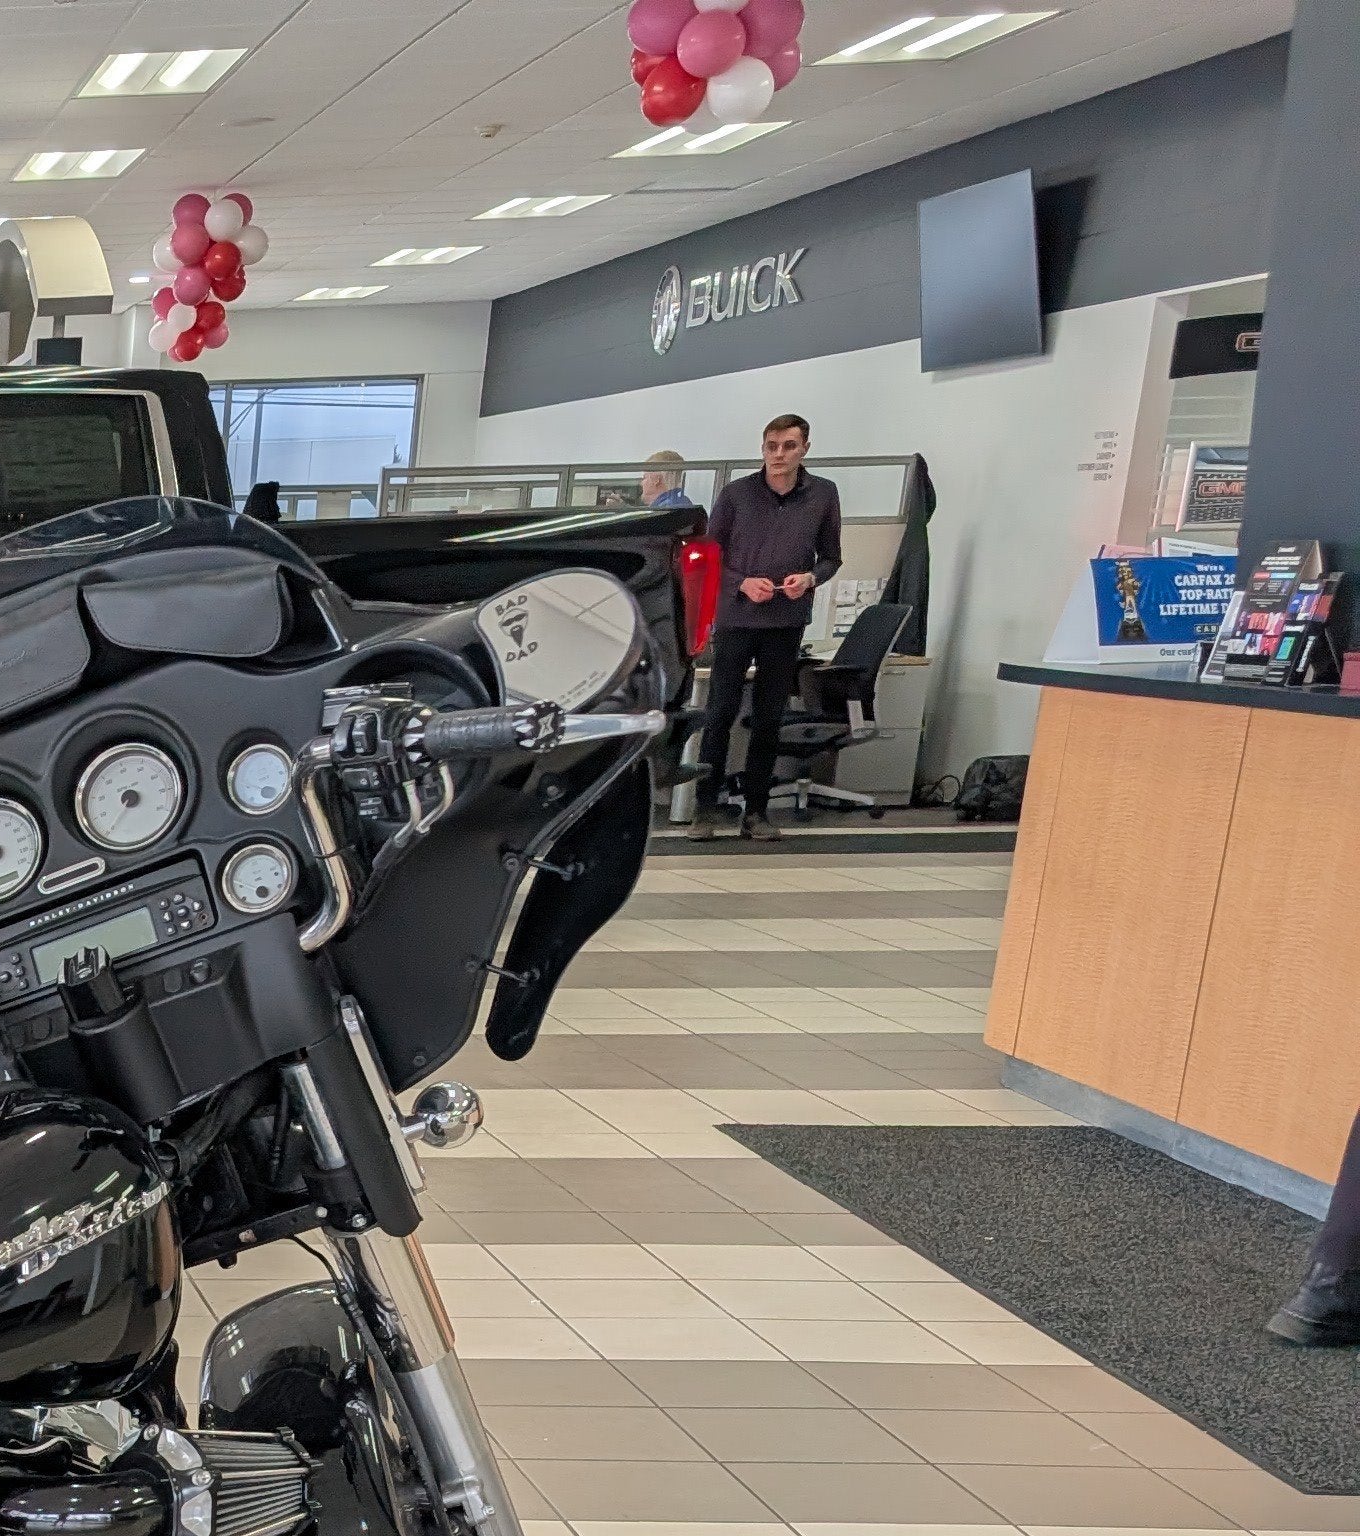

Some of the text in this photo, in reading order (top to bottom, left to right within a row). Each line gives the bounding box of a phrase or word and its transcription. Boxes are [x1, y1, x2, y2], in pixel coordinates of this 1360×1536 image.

[686, 248, 805, 328] BUICK
[1174, 573, 1223, 587] CARFAX
[1179, 588, 1235, 601] TOP-RAT
[495, 595, 528, 616] BAD
[1159, 603, 1219, 617] LIFETIME
[505, 641, 538, 662] DAD
